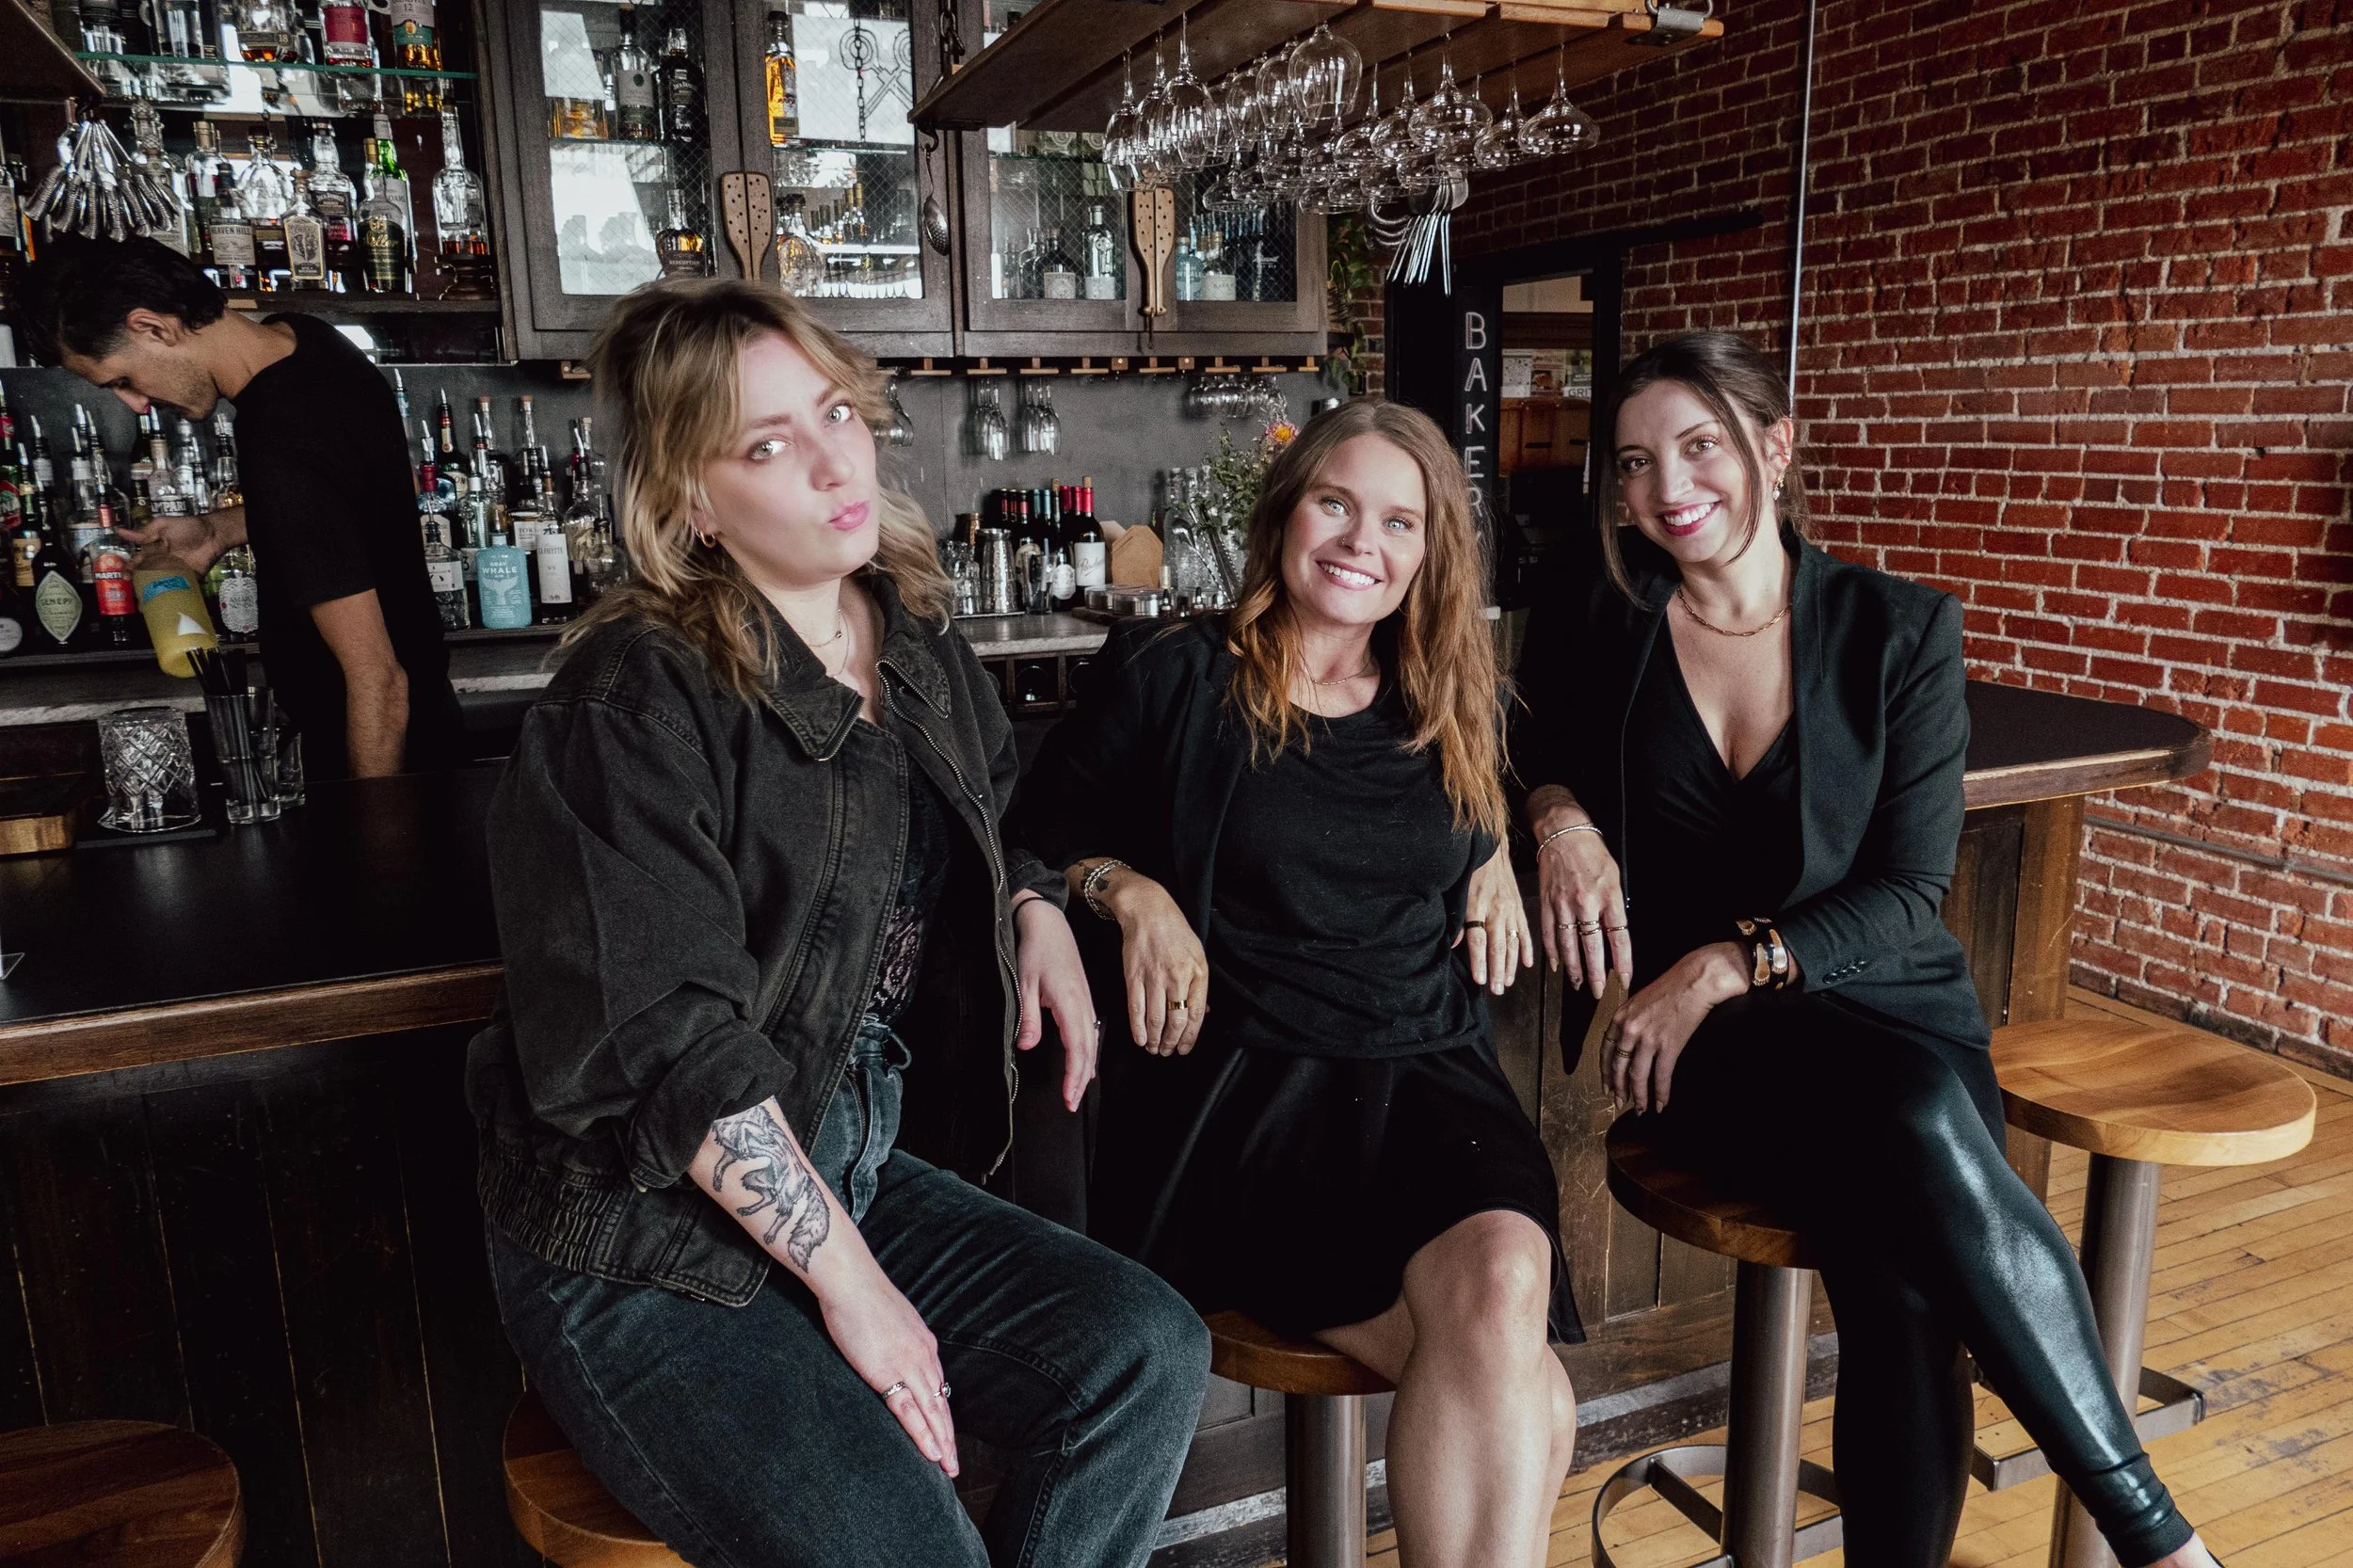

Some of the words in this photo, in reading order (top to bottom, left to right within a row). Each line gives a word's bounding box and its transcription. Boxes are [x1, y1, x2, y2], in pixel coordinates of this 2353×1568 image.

[279, 34, 289, 42] 18
[211, 226, 234, 234] HEAVEN
[1464, 312, 1488, 542] BAKER
[152, 501, 186, 513] AMPARI
